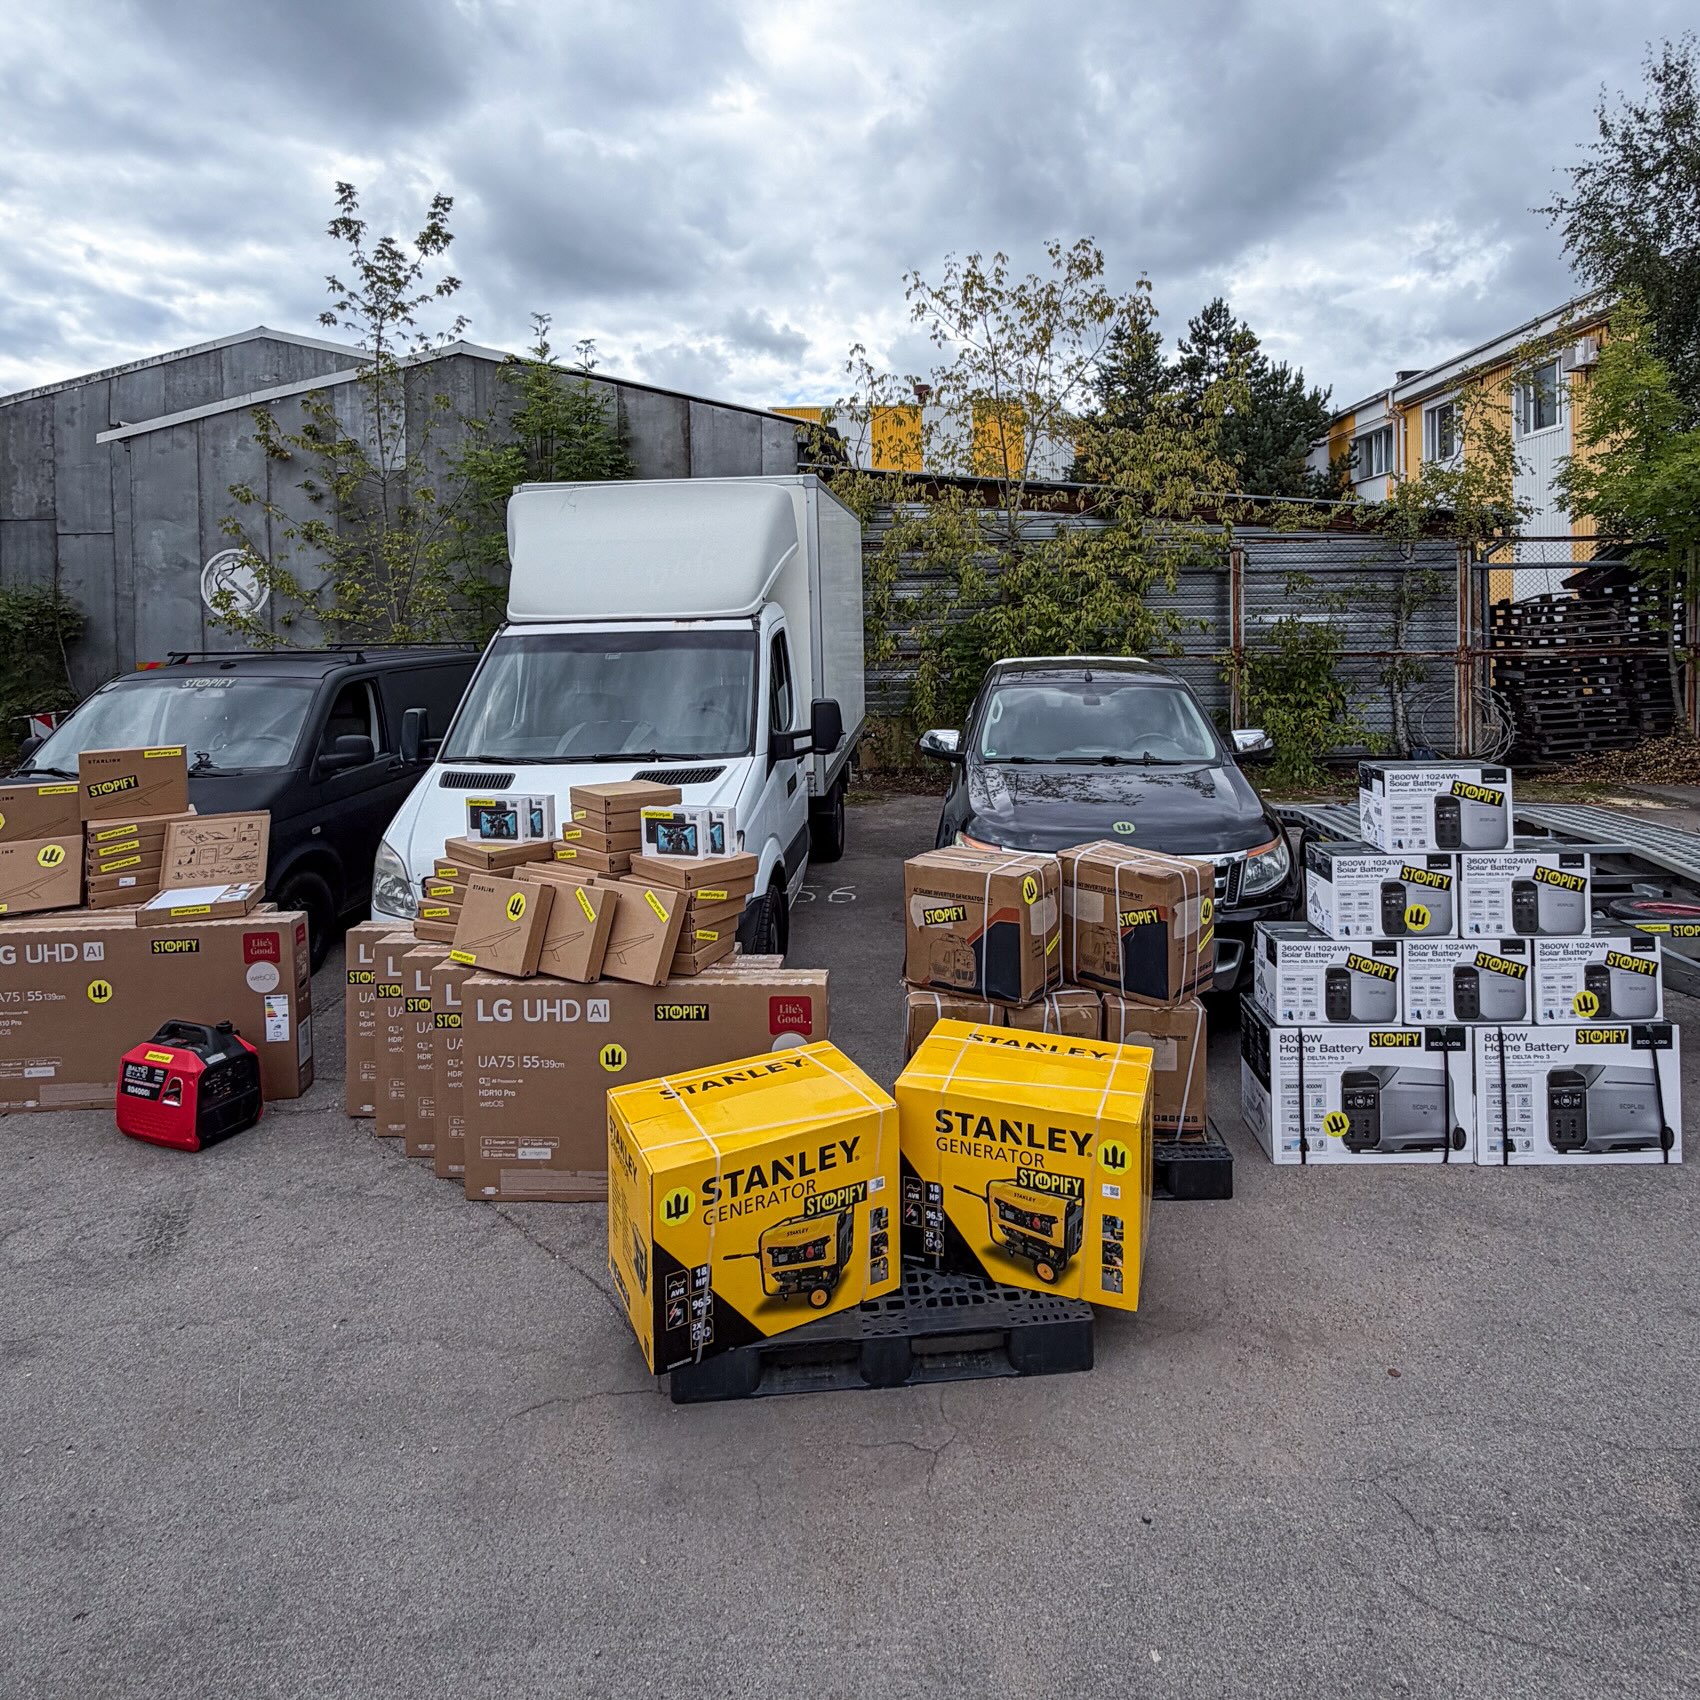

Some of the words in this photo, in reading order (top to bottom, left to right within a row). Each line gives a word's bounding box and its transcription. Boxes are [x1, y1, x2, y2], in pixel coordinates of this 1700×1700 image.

[182, 679, 236, 688] STOPIFY
[89, 776, 135, 796] STOPIFY
[1453, 782, 1502, 804] STOPIFY
[1401, 867, 1450, 889] STOPIFY
[1535, 867, 1585, 891] STOPIFY
[924, 907, 963, 924] STOPIFY
[1119, 909, 1158, 927] STOPIFY
[153, 940, 197, 953] STOPIFY
[251, 938, 272, 947] Life's
[25, 943, 79, 964] UHD
[85, 944, 103, 960] AI
[250, 947, 275, 955] Good.
[1431, 950, 1462, 958] Battery
[1348, 955, 1396, 980] STOPIFY
[1476, 953, 1526, 978] STOPIFY
[1607, 951, 1656, 975] STOPIFY
[27, 991, 42, 1001] 55
[378, 984, 404, 997] STO
[407, 999, 432, 1012] STO
[477, 999, 513, 1022] LG
[523, 999, 581, 1022] UHD
[588, 1001, 608, 1020] AI
[779, 1004, 804, 1014] Life's
[656, 1005, 707, 1020] STOPIFY
[777, 1014, 807, 1024] Good.
[436, 1014, 463, 1028] STO
[1371, 1033, 1419, 1046] STOPIFY
[1577, 1030, 1627, 1043] STOPIFY
[967, 1033, 1110, 1060] STANLEY
[1279, 1044, 1315, 1053] Home
[1320, 1044, 1364, 1054] Battery
[1484, 1043, 1521, 1052] Home
[1525, 1043, 1569, 1053] Battery
[478, 1055, 515, 1068] UA75
[522, 1055, 540, 1068] 55
[540, 1060, 565, 1069] 139cm
[659, 1058, 804, 1100] STANLEY
[478, 1089, 502, 1097] HDR10
[503, 1089, 516, 1097] Pro
[480, 1100, 504, 1108] webOS
[935, 1109, 1093, 1156] STANLEY
[936, 1136, 1045, 1168] GENERATOR
[701, 1136, 860, 1207] STANLEY
[929, 1184, 940, 1193] 18
[1019, 1169, 1081, 1196] STOPIFY
[703, 1179, 817, 1225] GENERATOR
[806, 1182, 864, 1215] STOPIFY
[908, 1192, 920, 1200] AVR
[929, 1193, 940, 1201] HP
[1014, 1192, 1036, 1203] STANLEY
[926, 1210, 943, 1221] 96.5
[786, 1228, 809, 1237] STANLEY
[695, 1266, 707, 1277] 18
[670, 1287, 684, 1298] AVR
[692, 1295, 711, 1311] 965
